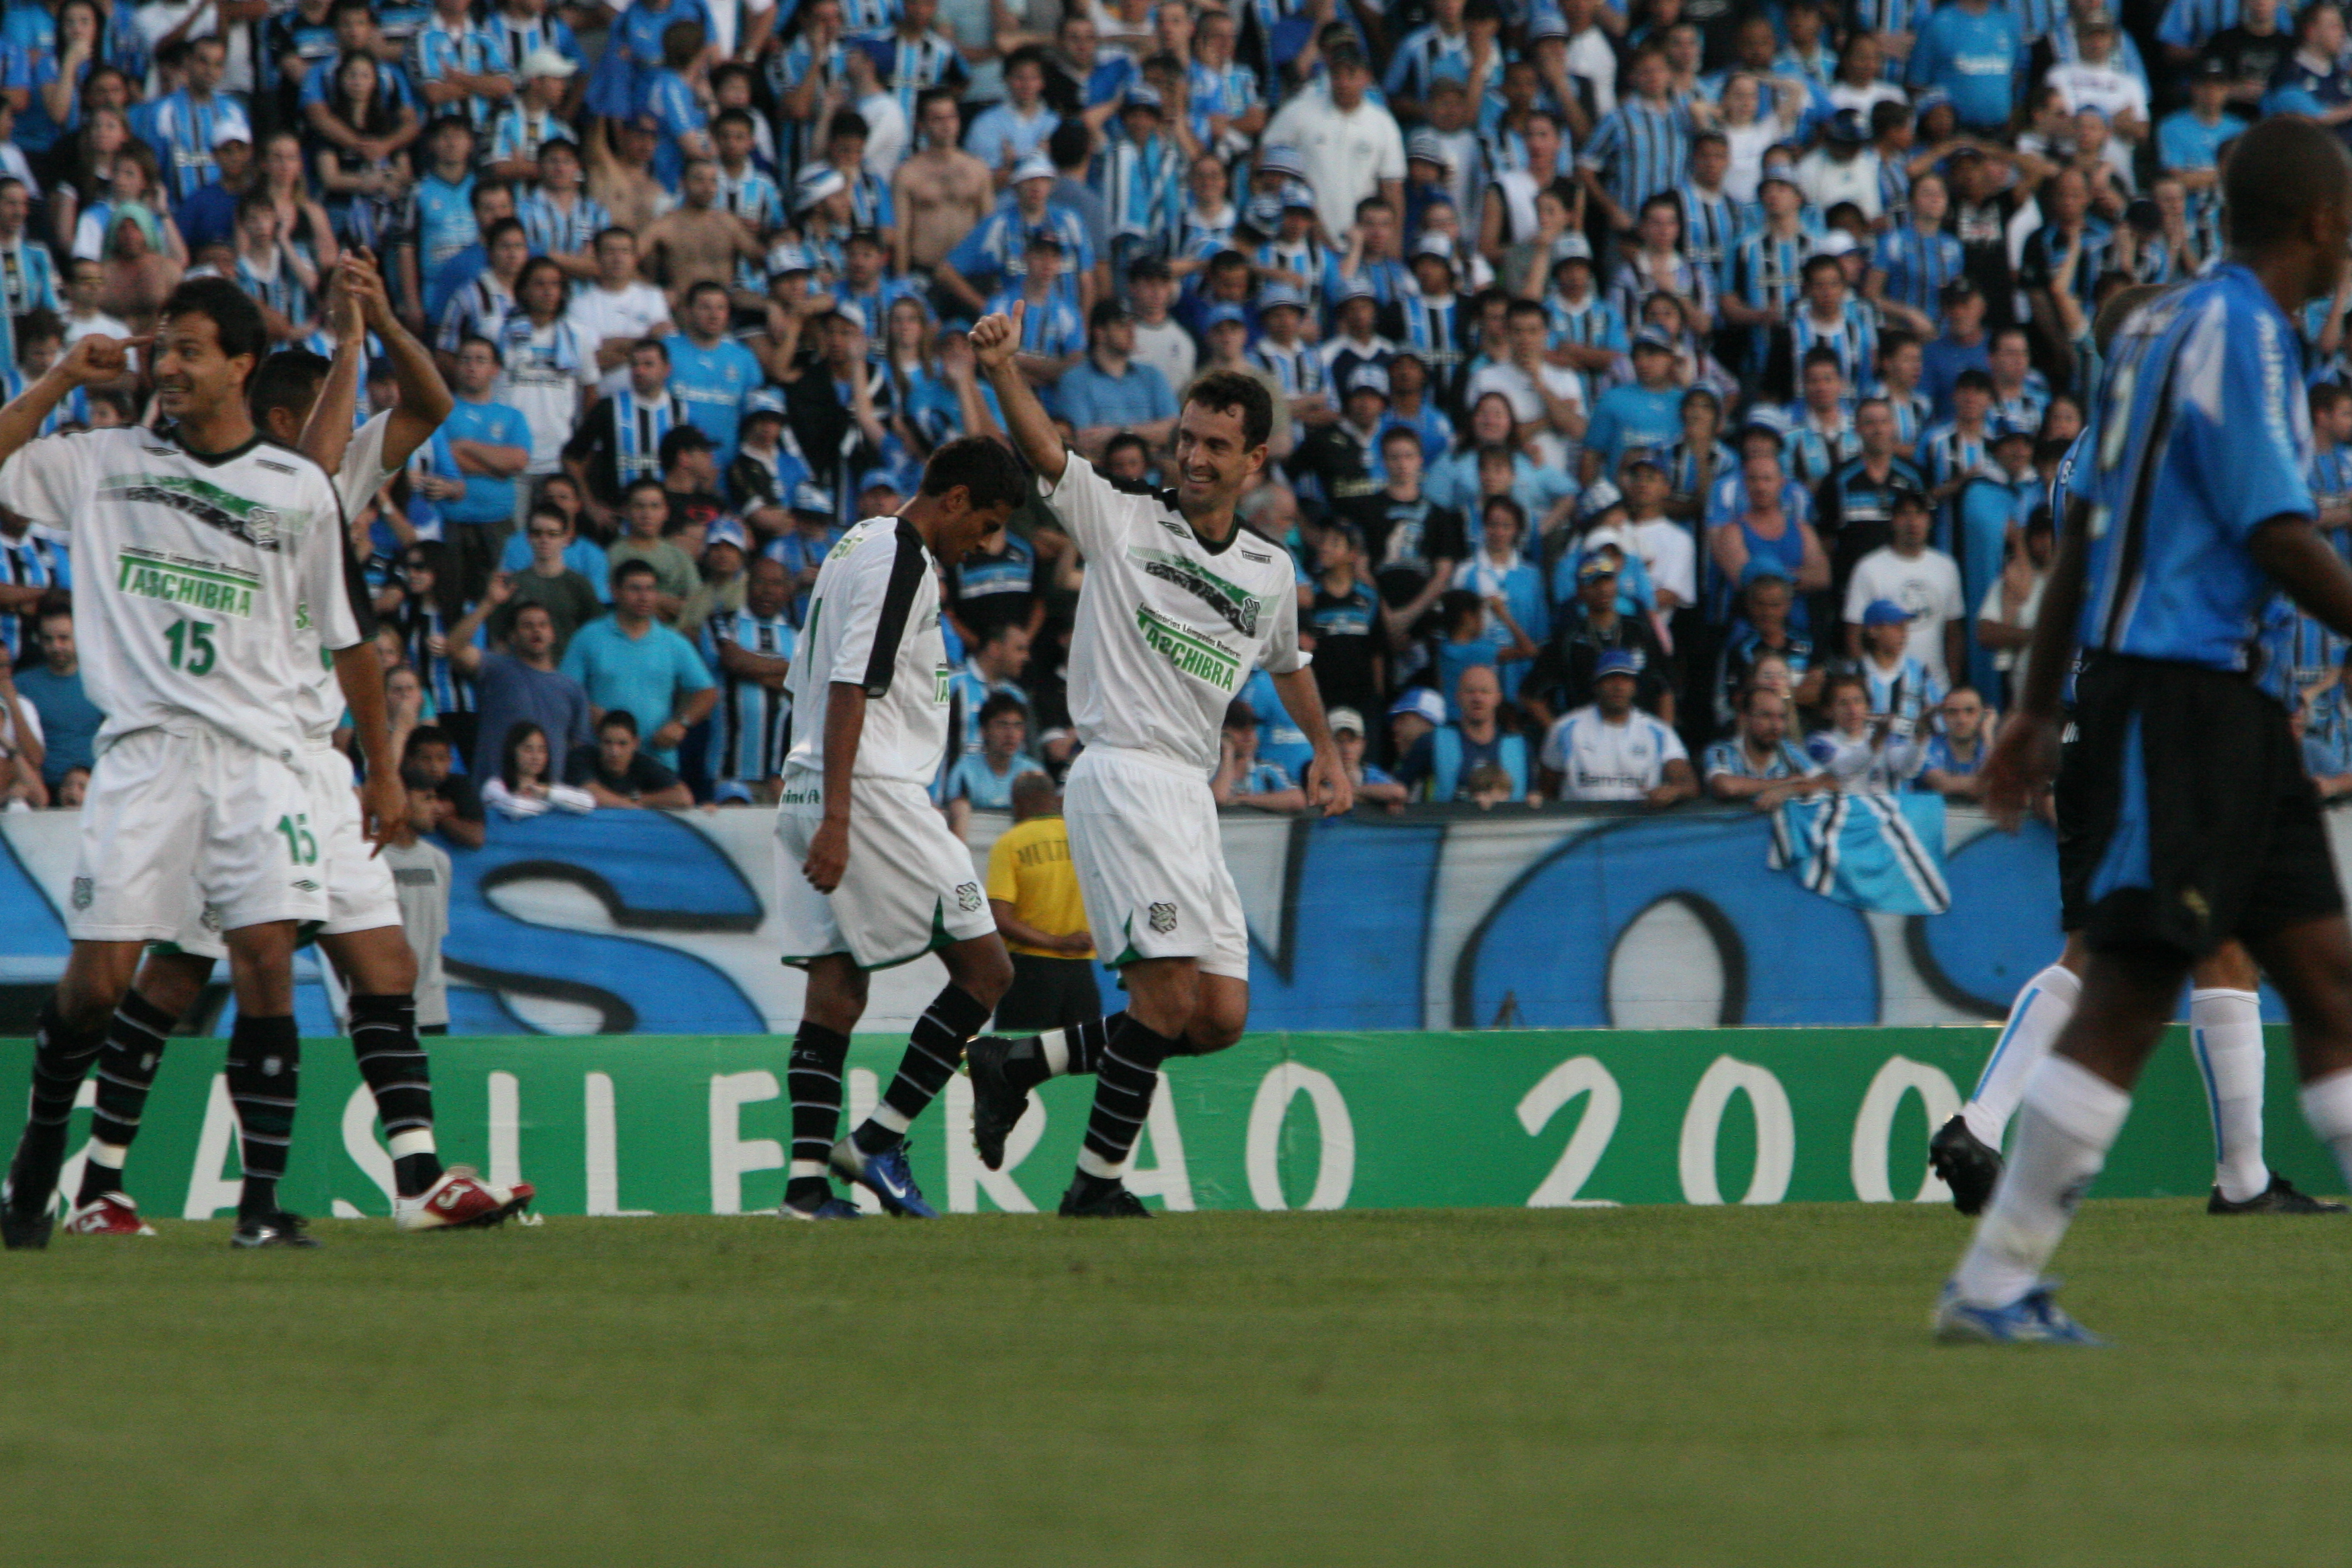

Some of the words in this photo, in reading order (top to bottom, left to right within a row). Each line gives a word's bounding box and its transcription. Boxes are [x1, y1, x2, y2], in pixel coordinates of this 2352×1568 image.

[117, 554, 263, 618] TASCHIBRA
[164, 618, 216, 676] 15
[1136, 608, 1240, 693] TASCHIBRA
[276, 813, 317, 865] 15
